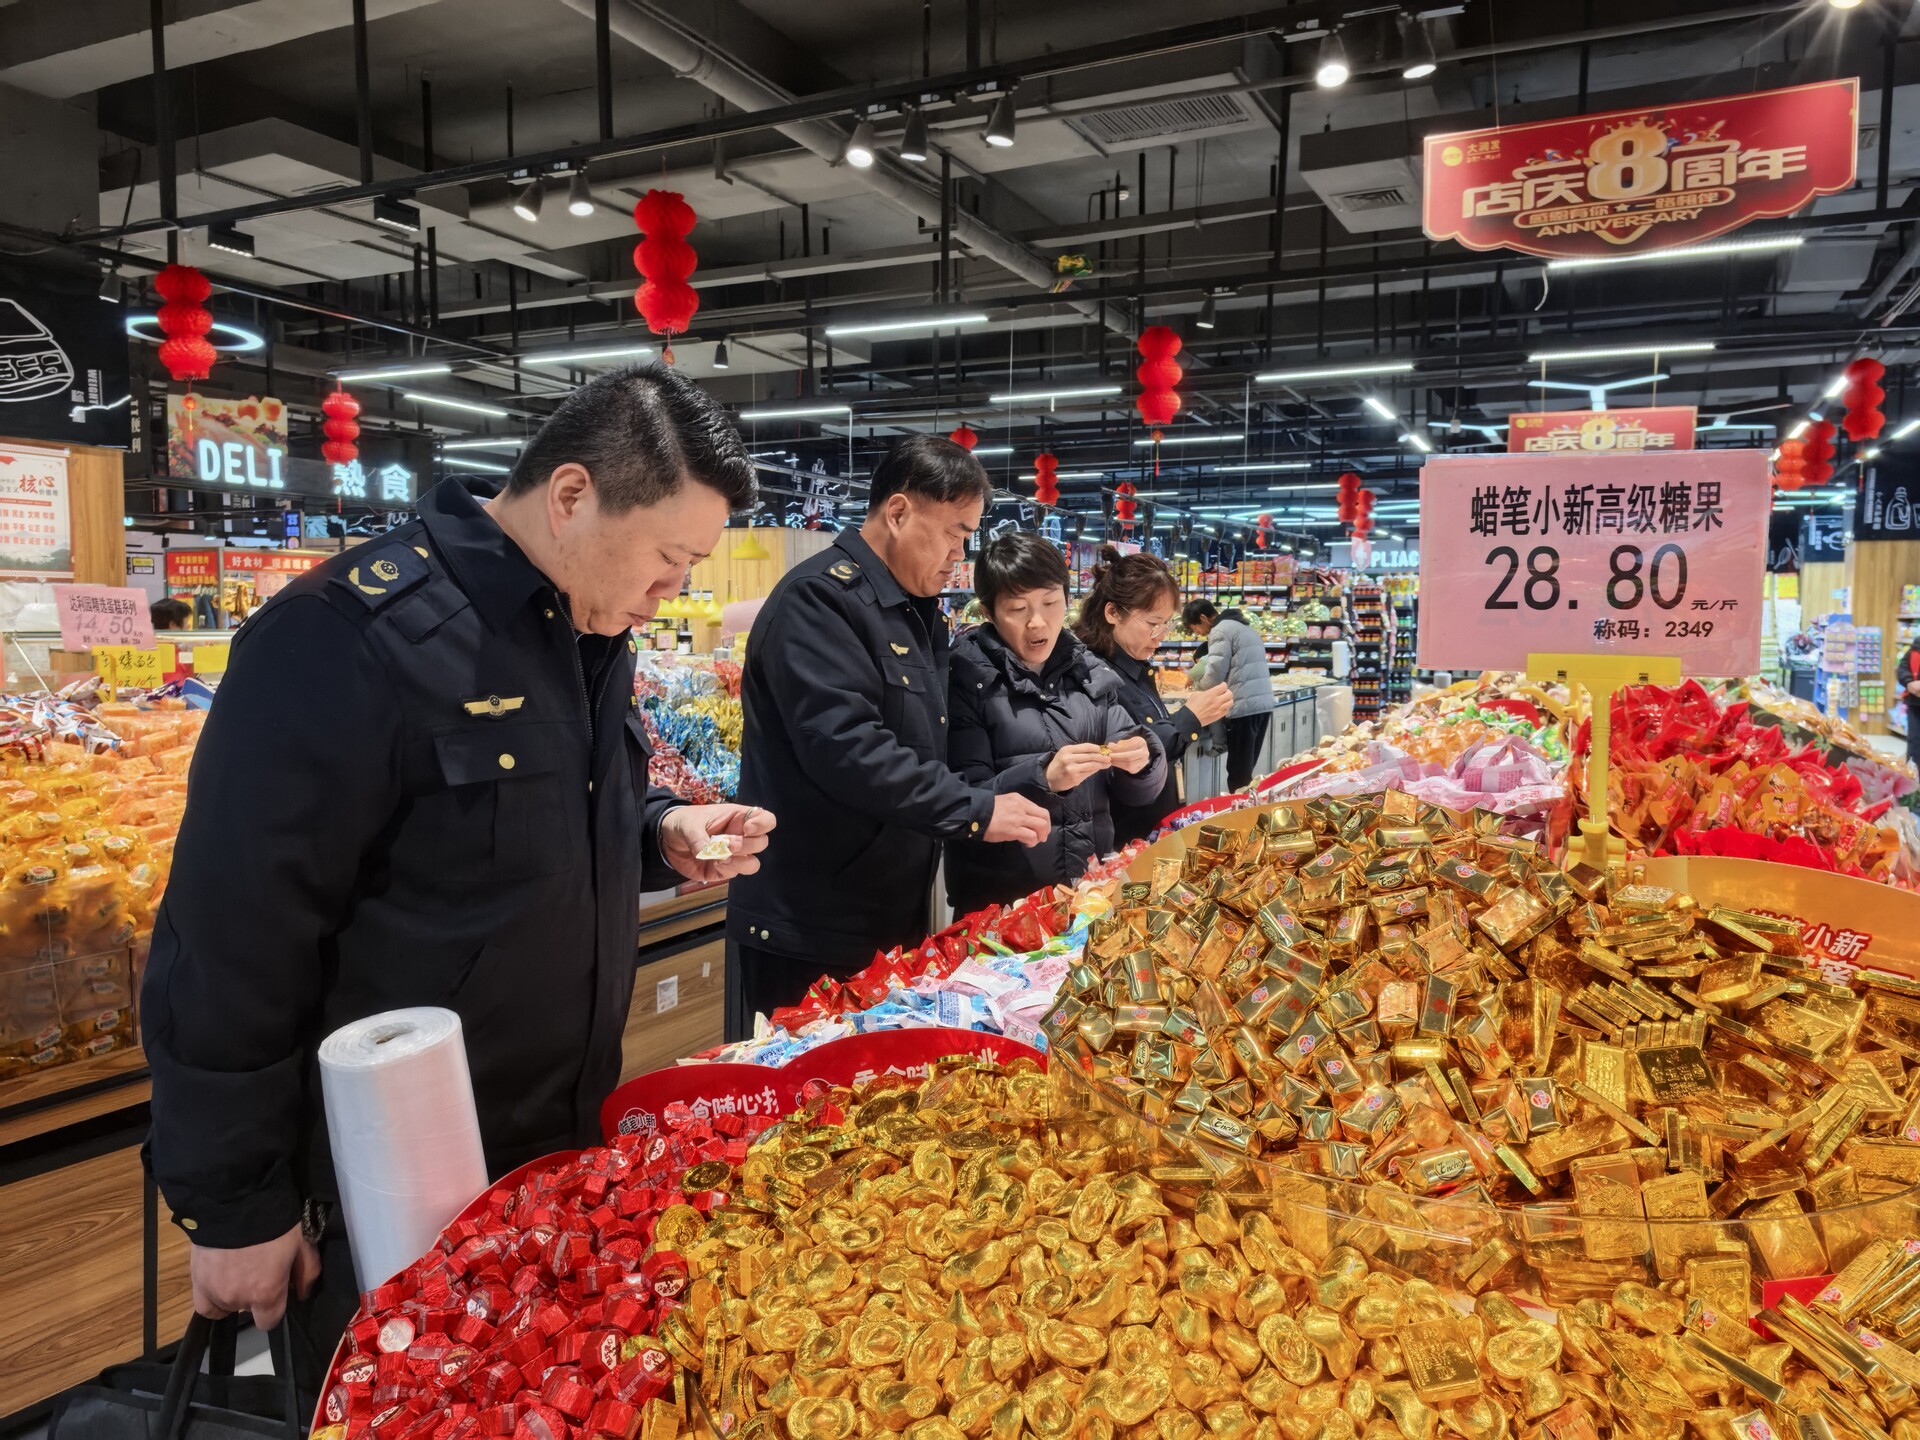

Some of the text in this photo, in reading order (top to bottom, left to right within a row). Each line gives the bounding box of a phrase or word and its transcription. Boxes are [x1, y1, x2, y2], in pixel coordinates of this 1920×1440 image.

[1462, 126, 1807, 219] 店庆8周年
[1536, 207, 1703, 238] ANNIVERSARY
[87, 369, 99, 405] WEIGHT
[1524, 418, 1675, 452] 店庆8周年
[198, 438, 285, 489] DELI
[332, 458, 412, 503] 熟食
[19, 473, 55, 495] 核心
[1470, 480, 1722, 538] 蜡笔小新高级糖果
[231, 555, 263, 569] 好食材
[1484, 543, 1739, 612] 28.80 元/斤
[618, 1113, 656, 1136] 蜡笔小新
[673, 1085, 780, 1126] 食随心
